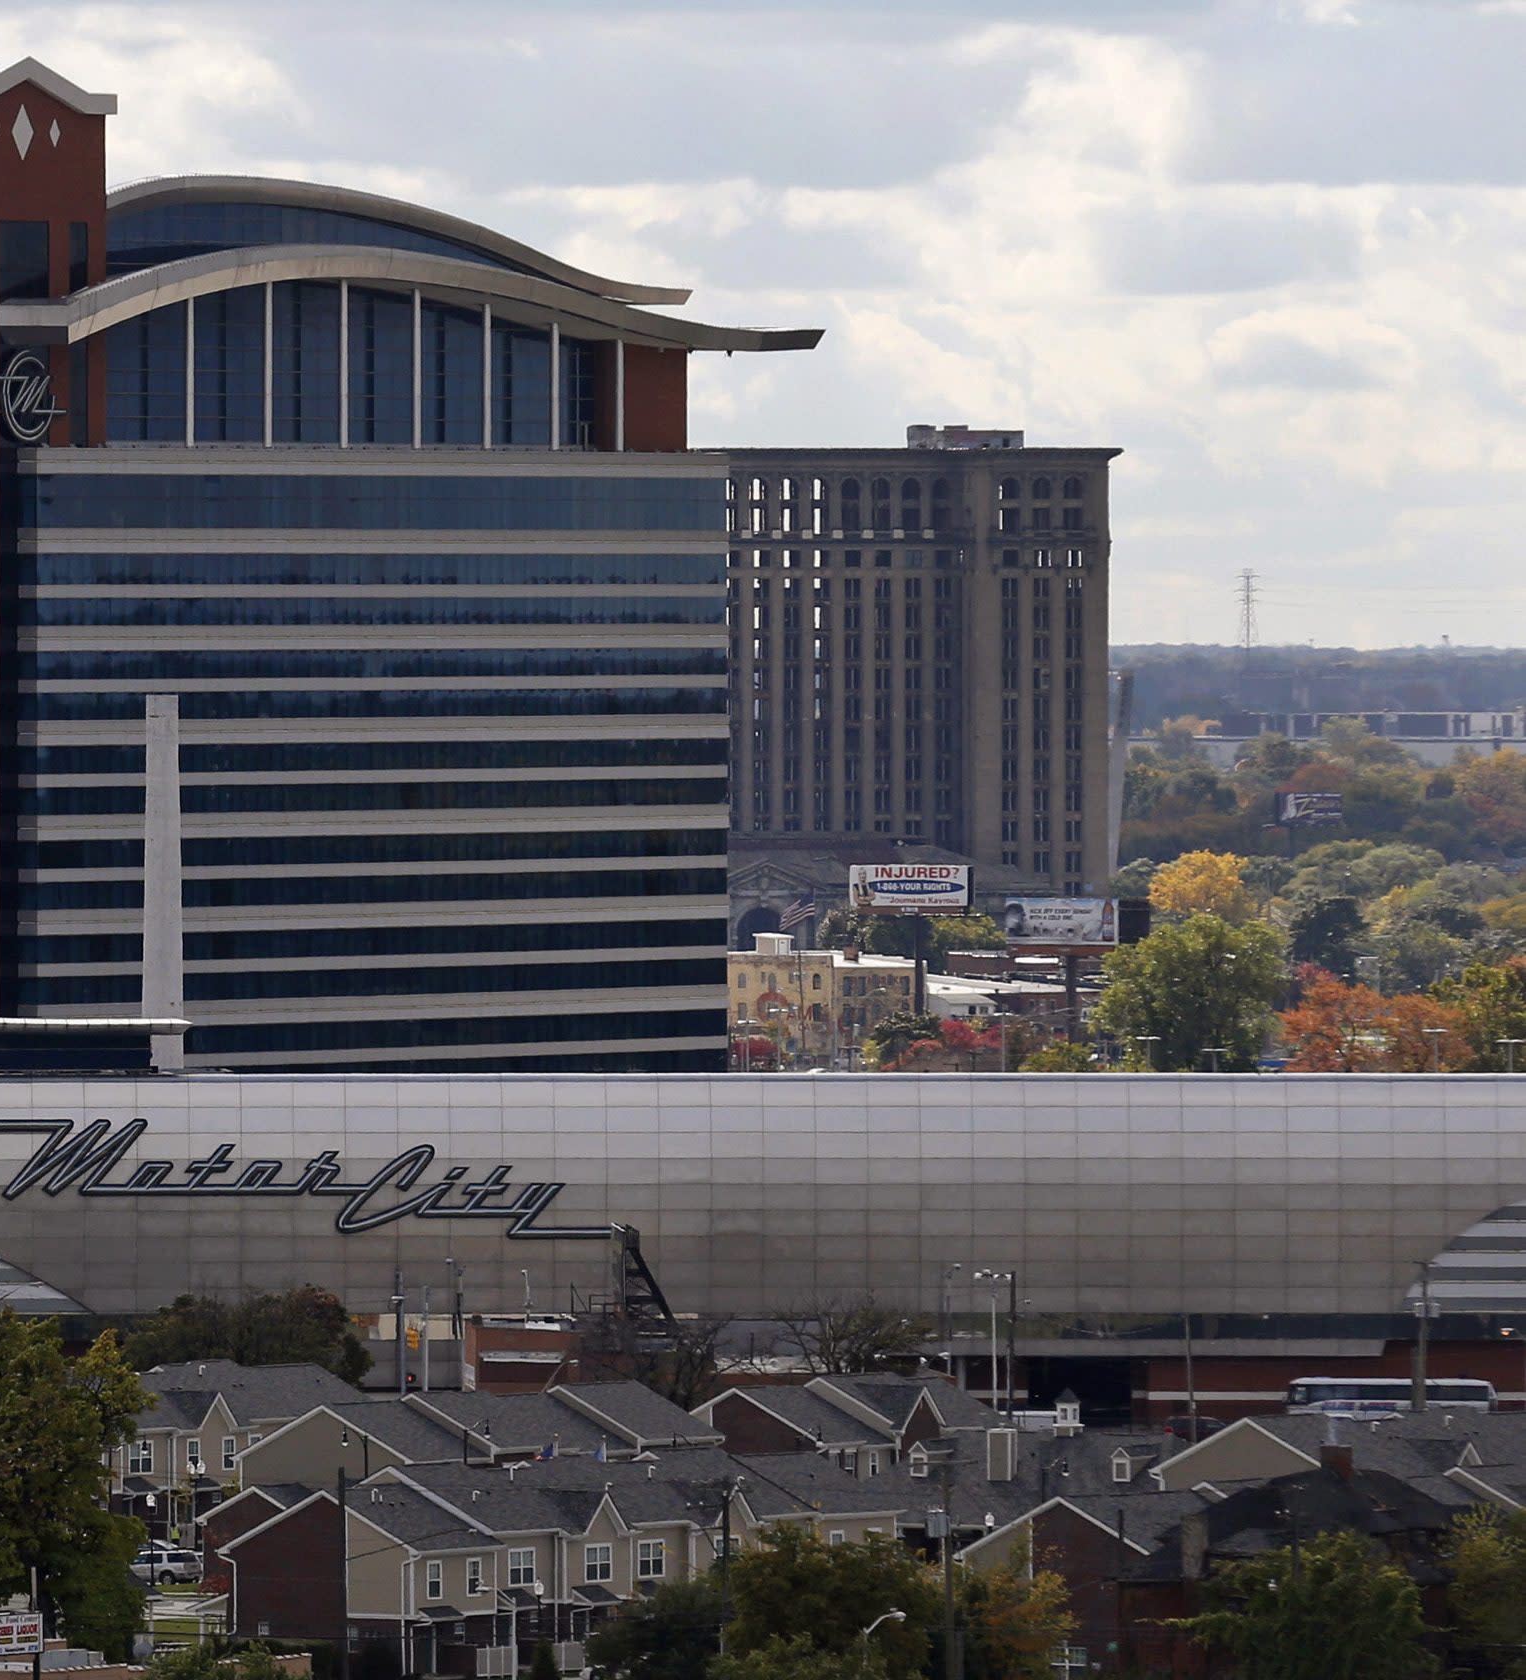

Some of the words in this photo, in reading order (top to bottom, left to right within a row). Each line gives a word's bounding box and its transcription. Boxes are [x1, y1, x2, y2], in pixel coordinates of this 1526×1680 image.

[875, 867, 960, 879] INJURED?
[923, 883, 951, 891] RIGHTS
[17, 1624, 38, 1635] LIQUOR
